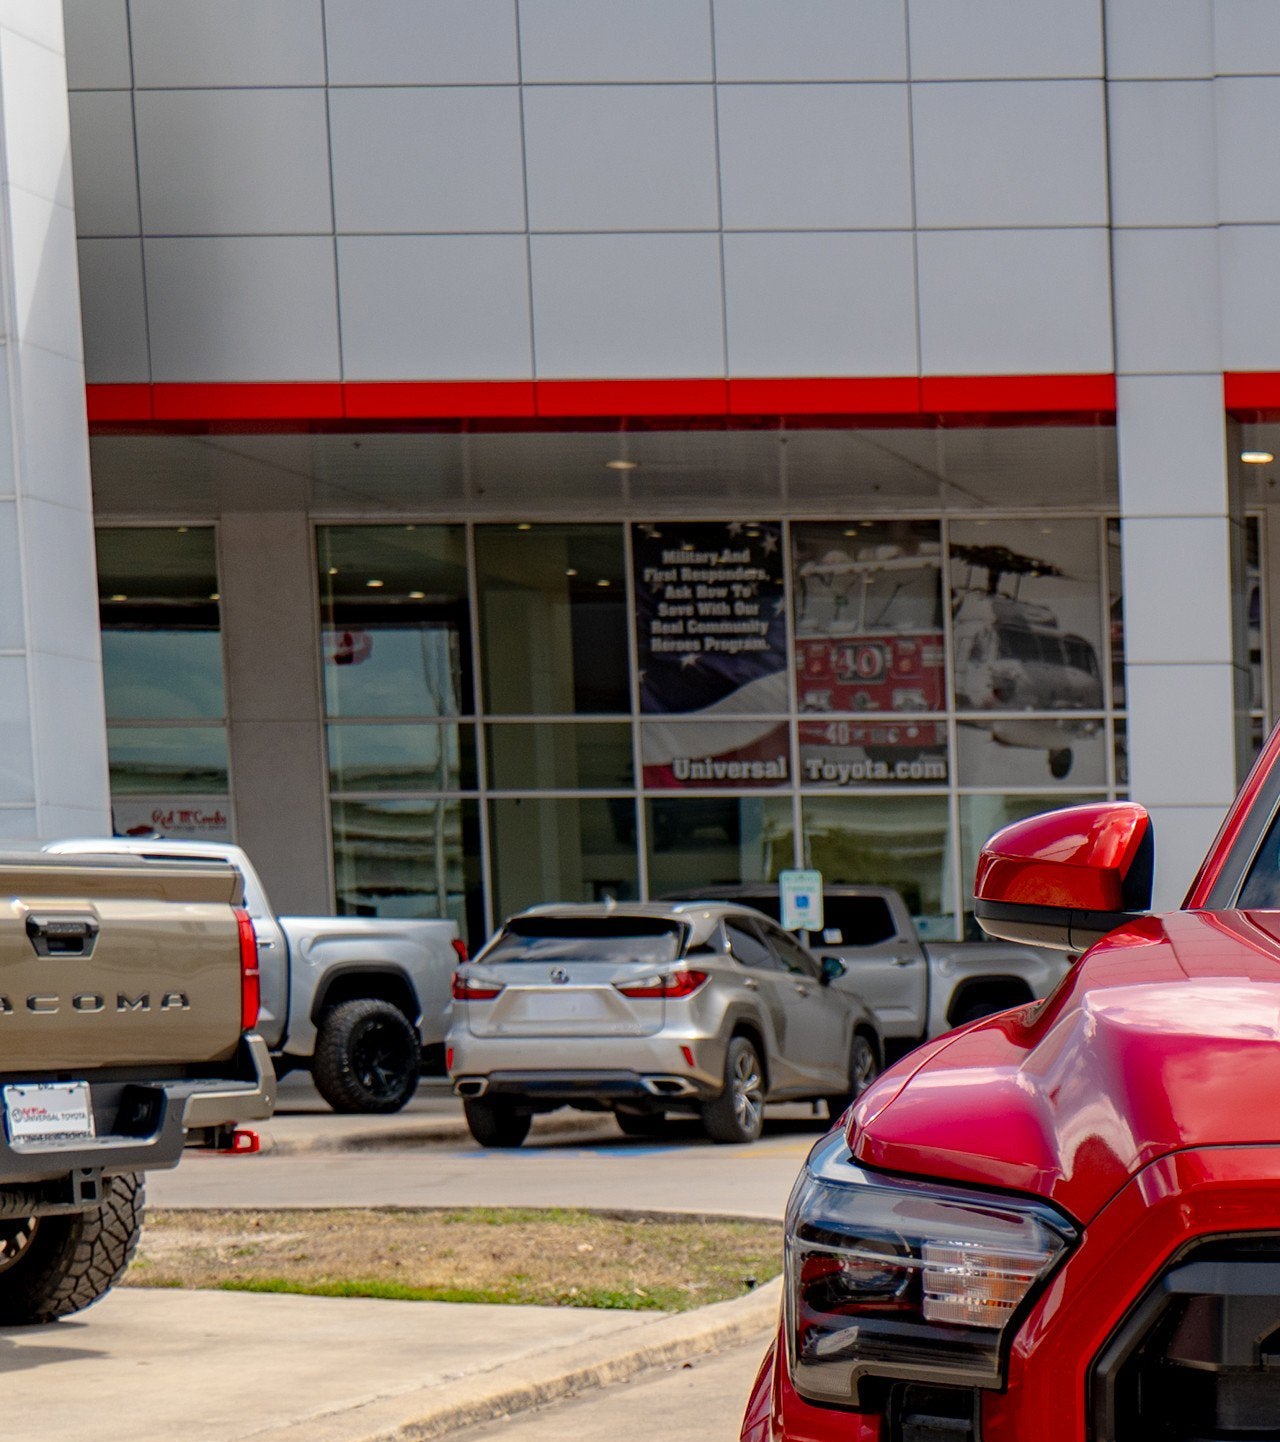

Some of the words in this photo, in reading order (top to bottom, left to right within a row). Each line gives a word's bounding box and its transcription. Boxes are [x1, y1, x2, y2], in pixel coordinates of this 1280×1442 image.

[661, 550, 719, 566] Military
[721, 549, 751, 564] And
[643, 568, 678, 582] First
[664, 584, 693, 599] Ask
[695, 584, 728, 599] How
[731, 583, 752, 598] To
[657, 602, 695, 617] Save
[697, 601, 732, 616] With
[733, 601, 760, 616] Our
[650, 620, 685, 635] Real
[686, 619, 769, 636] Community
[650, 637, 701, 652] Heroes
[834, 647, 883, 678] 40
[671, 756, 788, 780] Universal
[805, 757, 947, 784] Toyota.com
